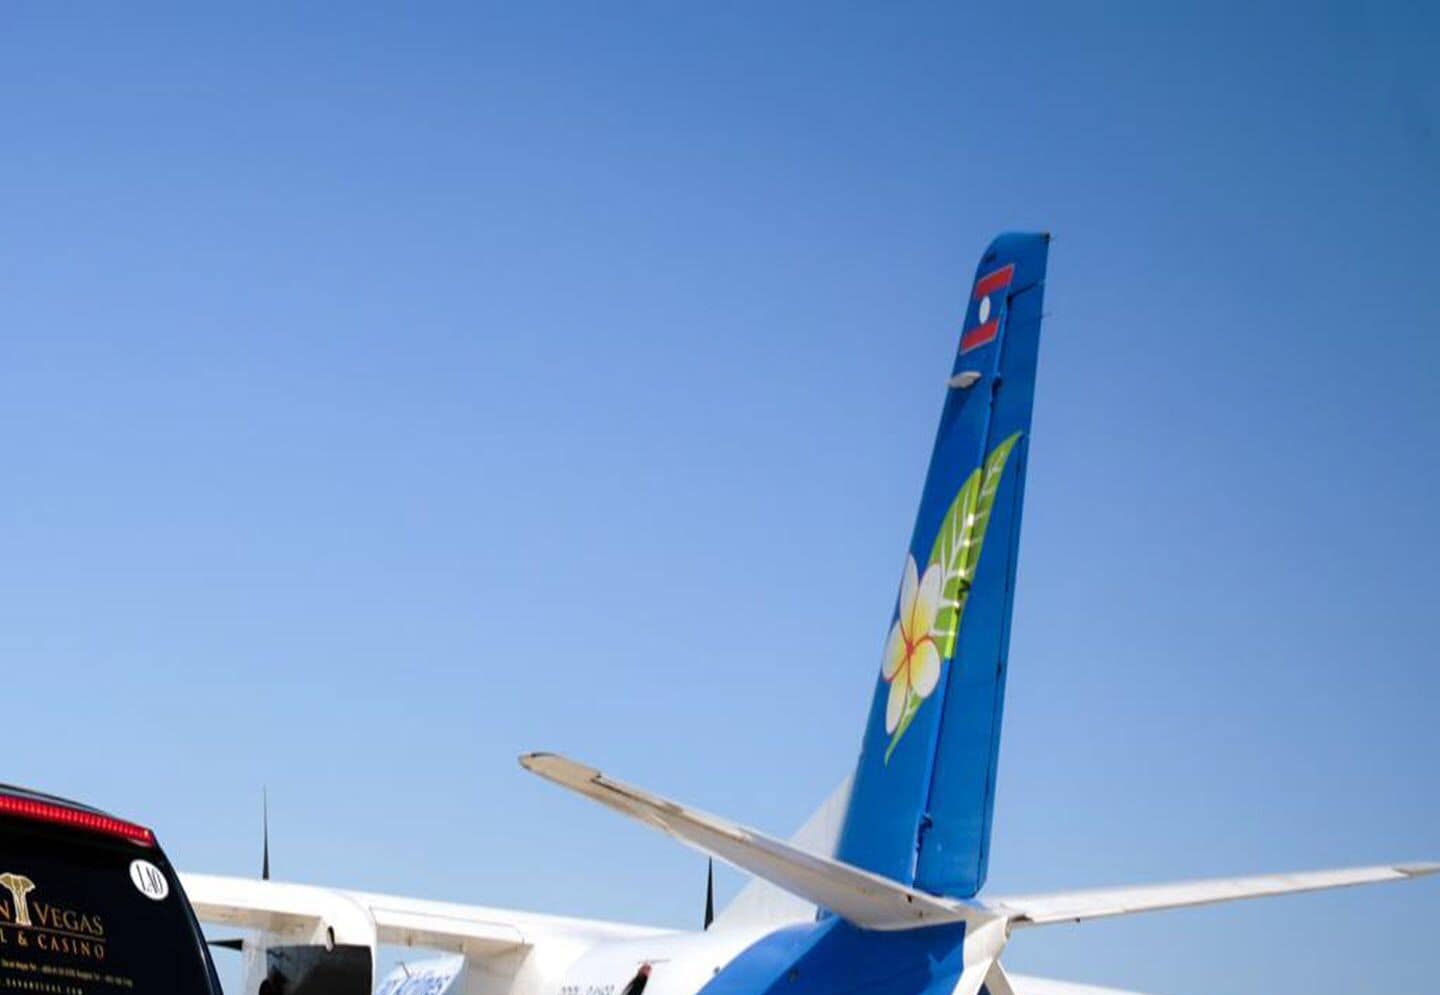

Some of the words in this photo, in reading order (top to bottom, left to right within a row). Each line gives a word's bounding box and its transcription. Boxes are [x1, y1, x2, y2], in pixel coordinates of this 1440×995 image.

[32, 901, 104, 936] VEGAS
[17, 932, 29, 947] &
[37, 933, 104, 960] CASINO
